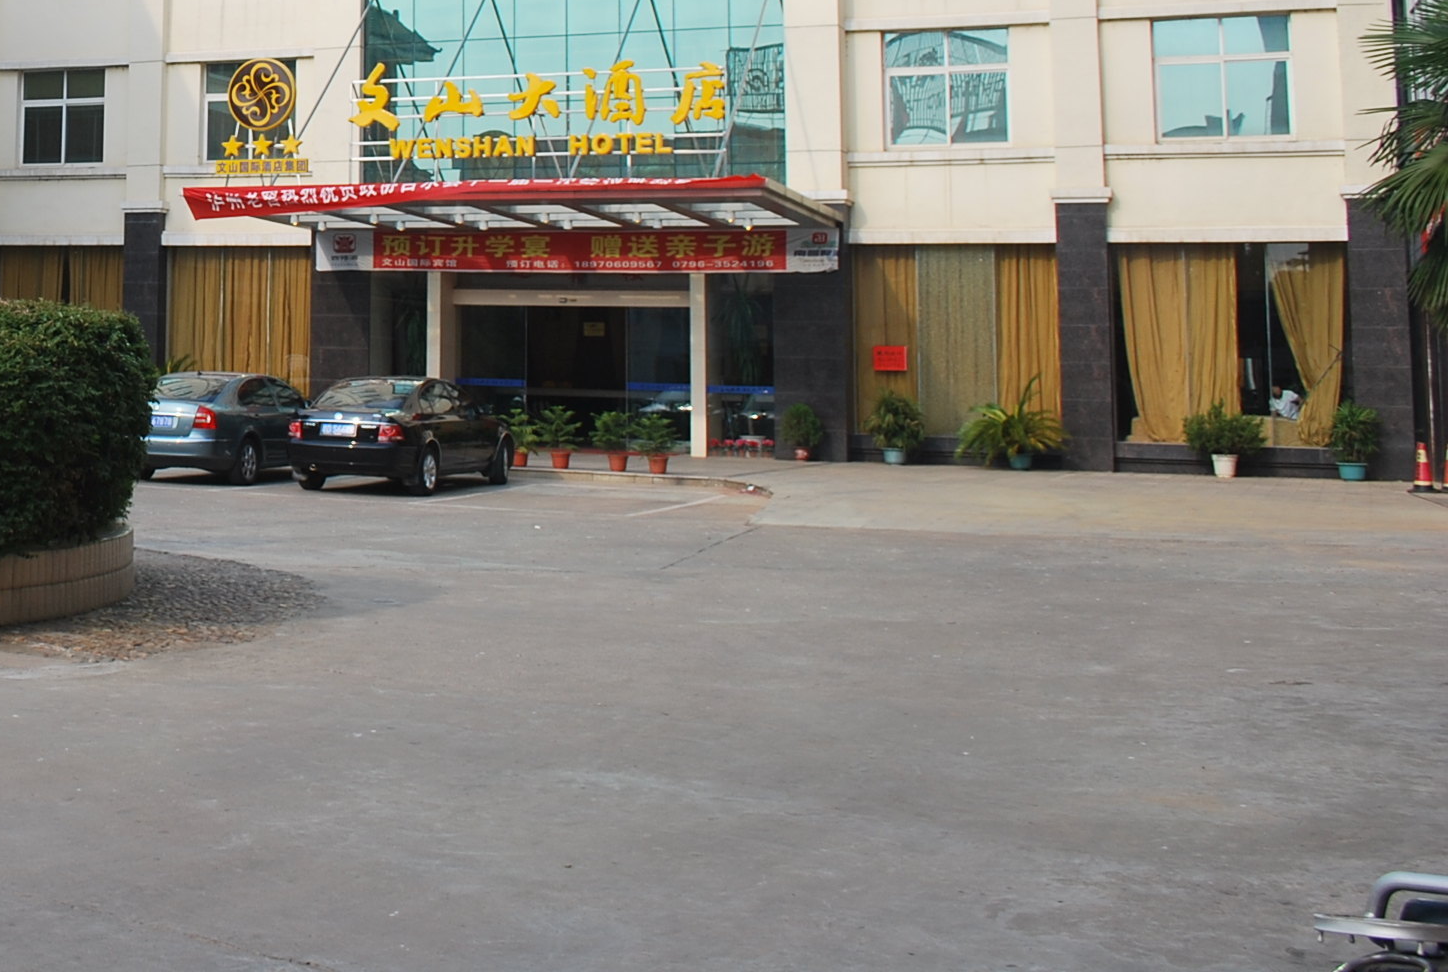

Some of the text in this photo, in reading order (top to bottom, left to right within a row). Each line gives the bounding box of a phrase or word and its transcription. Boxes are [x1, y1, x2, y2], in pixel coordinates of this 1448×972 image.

[349, 60, 725, 131] 文山大酒店
[389, 132, 673, 160] WENSHAN HOTEL
[217, 161, 306, 174] 文山国际酒店集团
[382, 234, 776, 258] 预订升学宴 赠送亲子游
[381, 258, 458, 268] 文山国际宾馆
